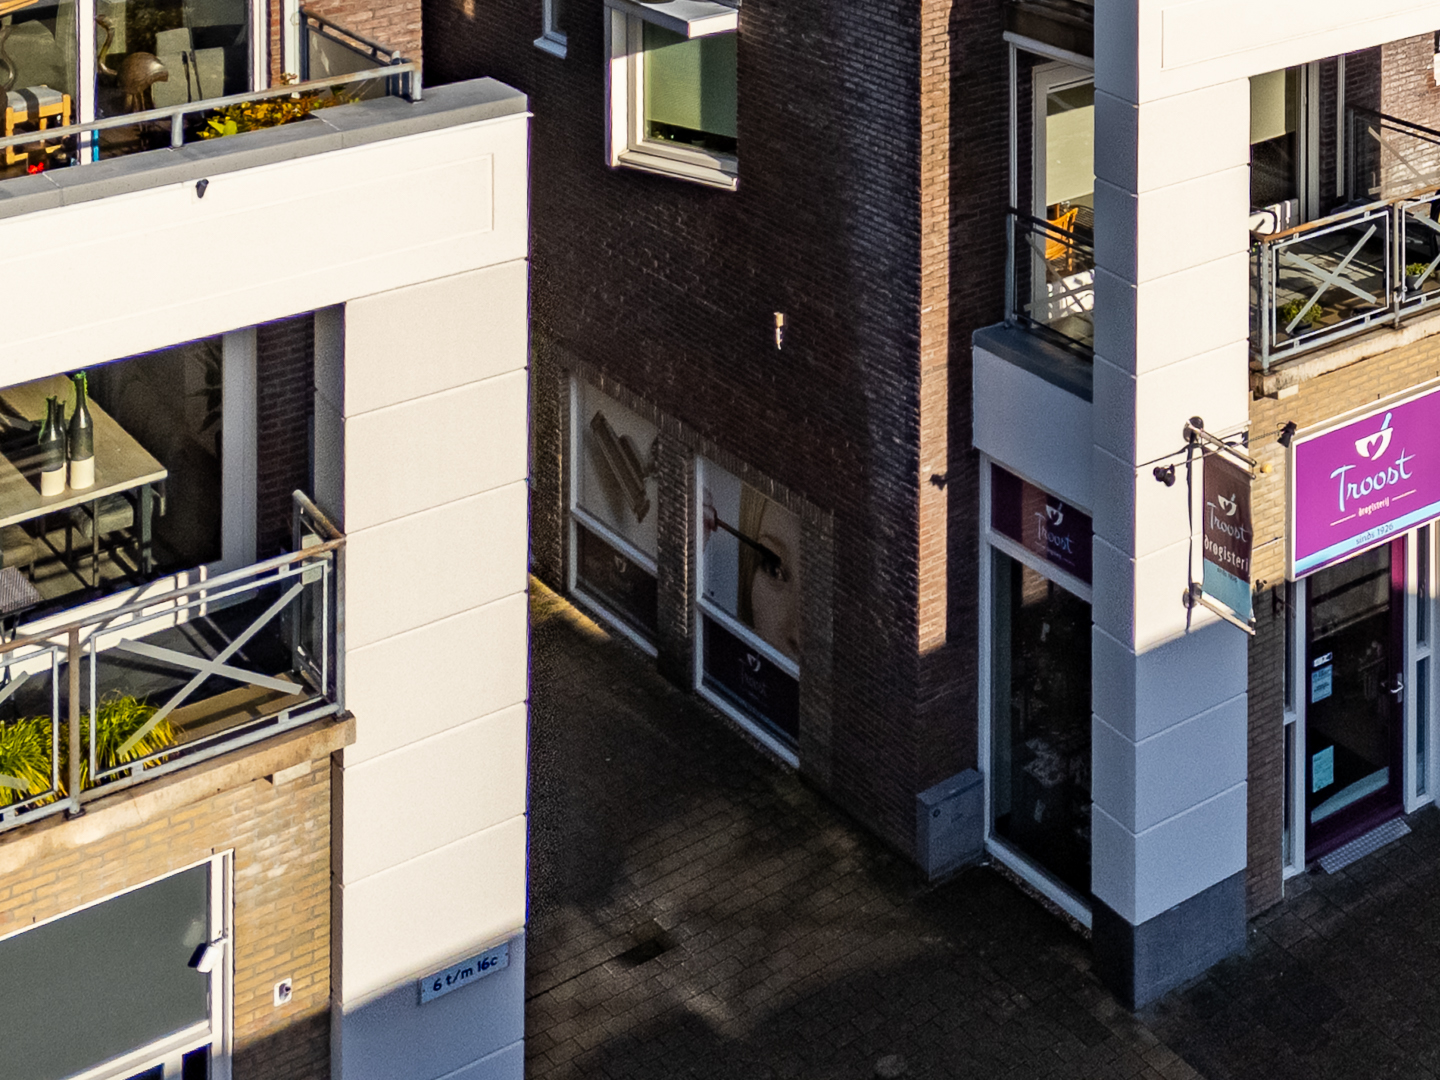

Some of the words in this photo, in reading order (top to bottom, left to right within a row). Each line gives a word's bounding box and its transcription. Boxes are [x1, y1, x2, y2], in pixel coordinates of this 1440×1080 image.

[1330, 448, 1415, 512] Troost
[1207, 501, 1251, 542] Troost
[1358, 496, 1390, 517] drogisterij
[1035, 513, 1074, 554] Troost
[1355, 529, 1375, 545] sinds
[1377, 523, 1394, 539] 1926
[433, 978, 442, 991] 6
[446, 968, 473, 985] t/m
[477, 956, 498, 972] 16c
